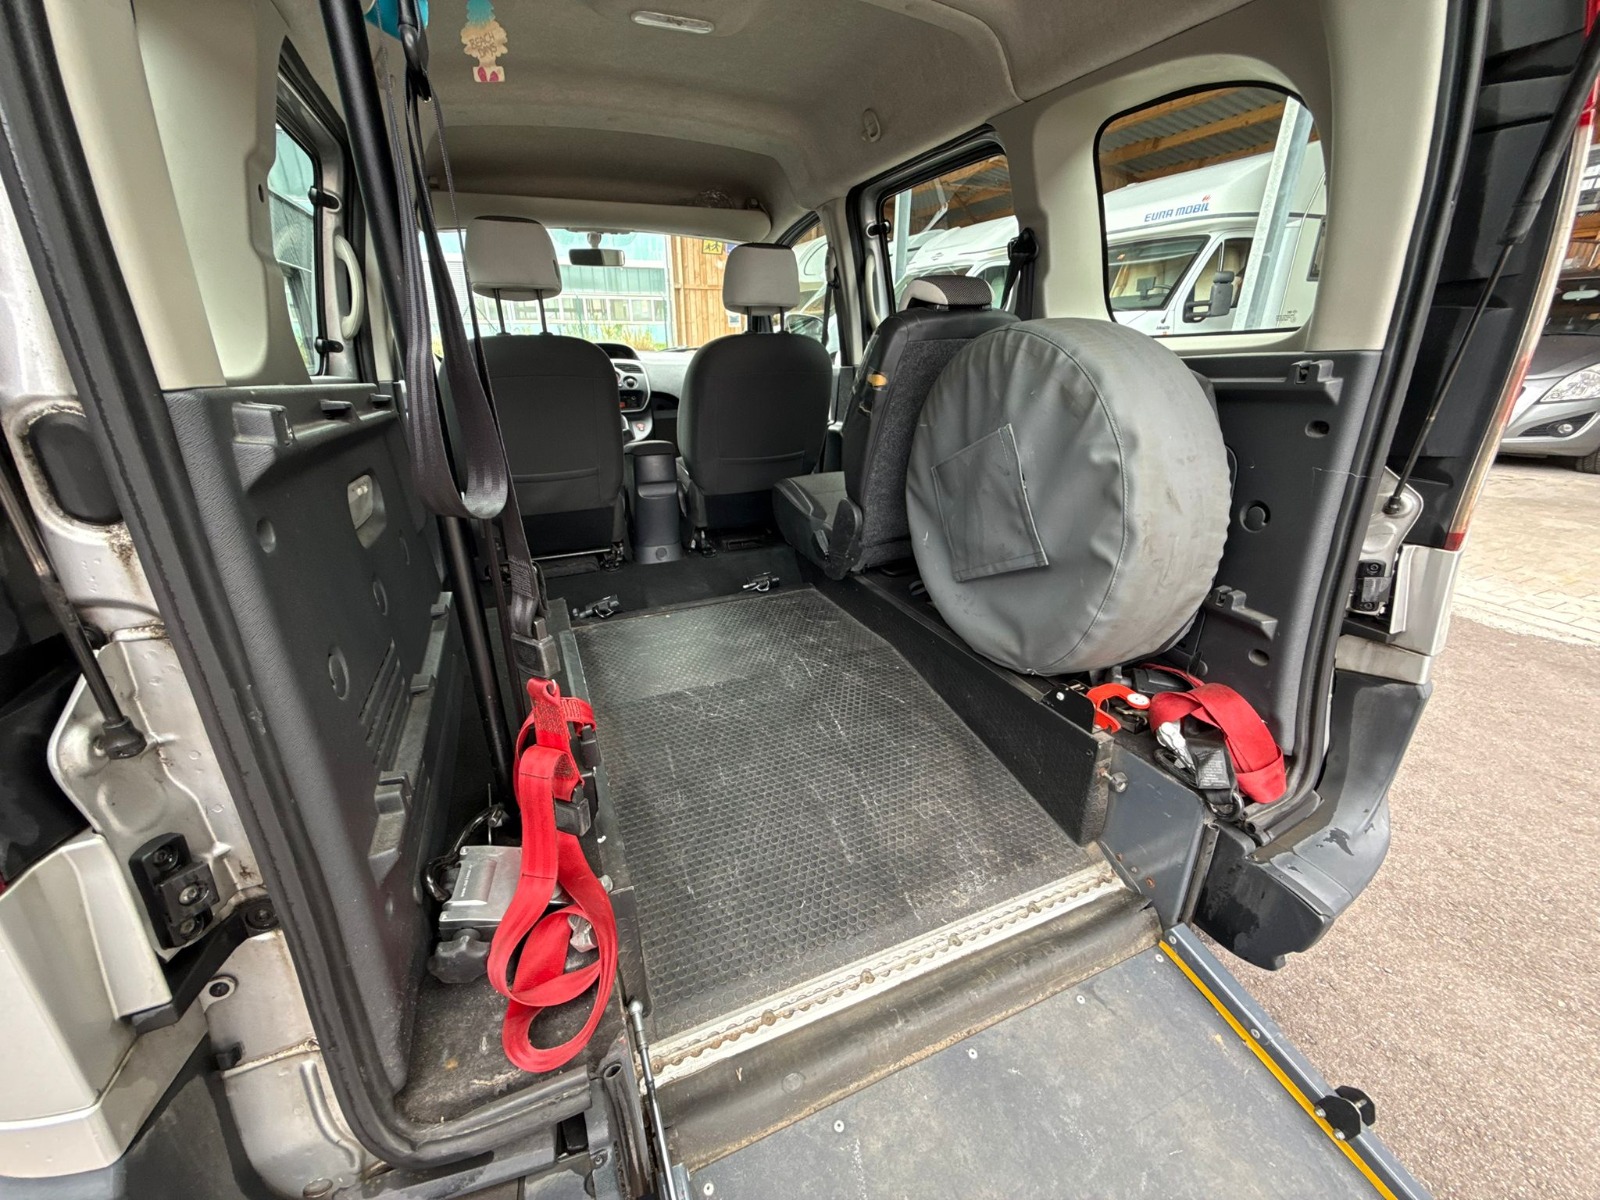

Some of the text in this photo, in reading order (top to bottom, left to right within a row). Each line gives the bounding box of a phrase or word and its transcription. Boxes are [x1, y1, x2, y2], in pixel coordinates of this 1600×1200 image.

[469, 32, 495, 49] BEACH
[478, 42, 497, 58] DAYS
[1144, 203, 1209, 222] EURA MOBIL
